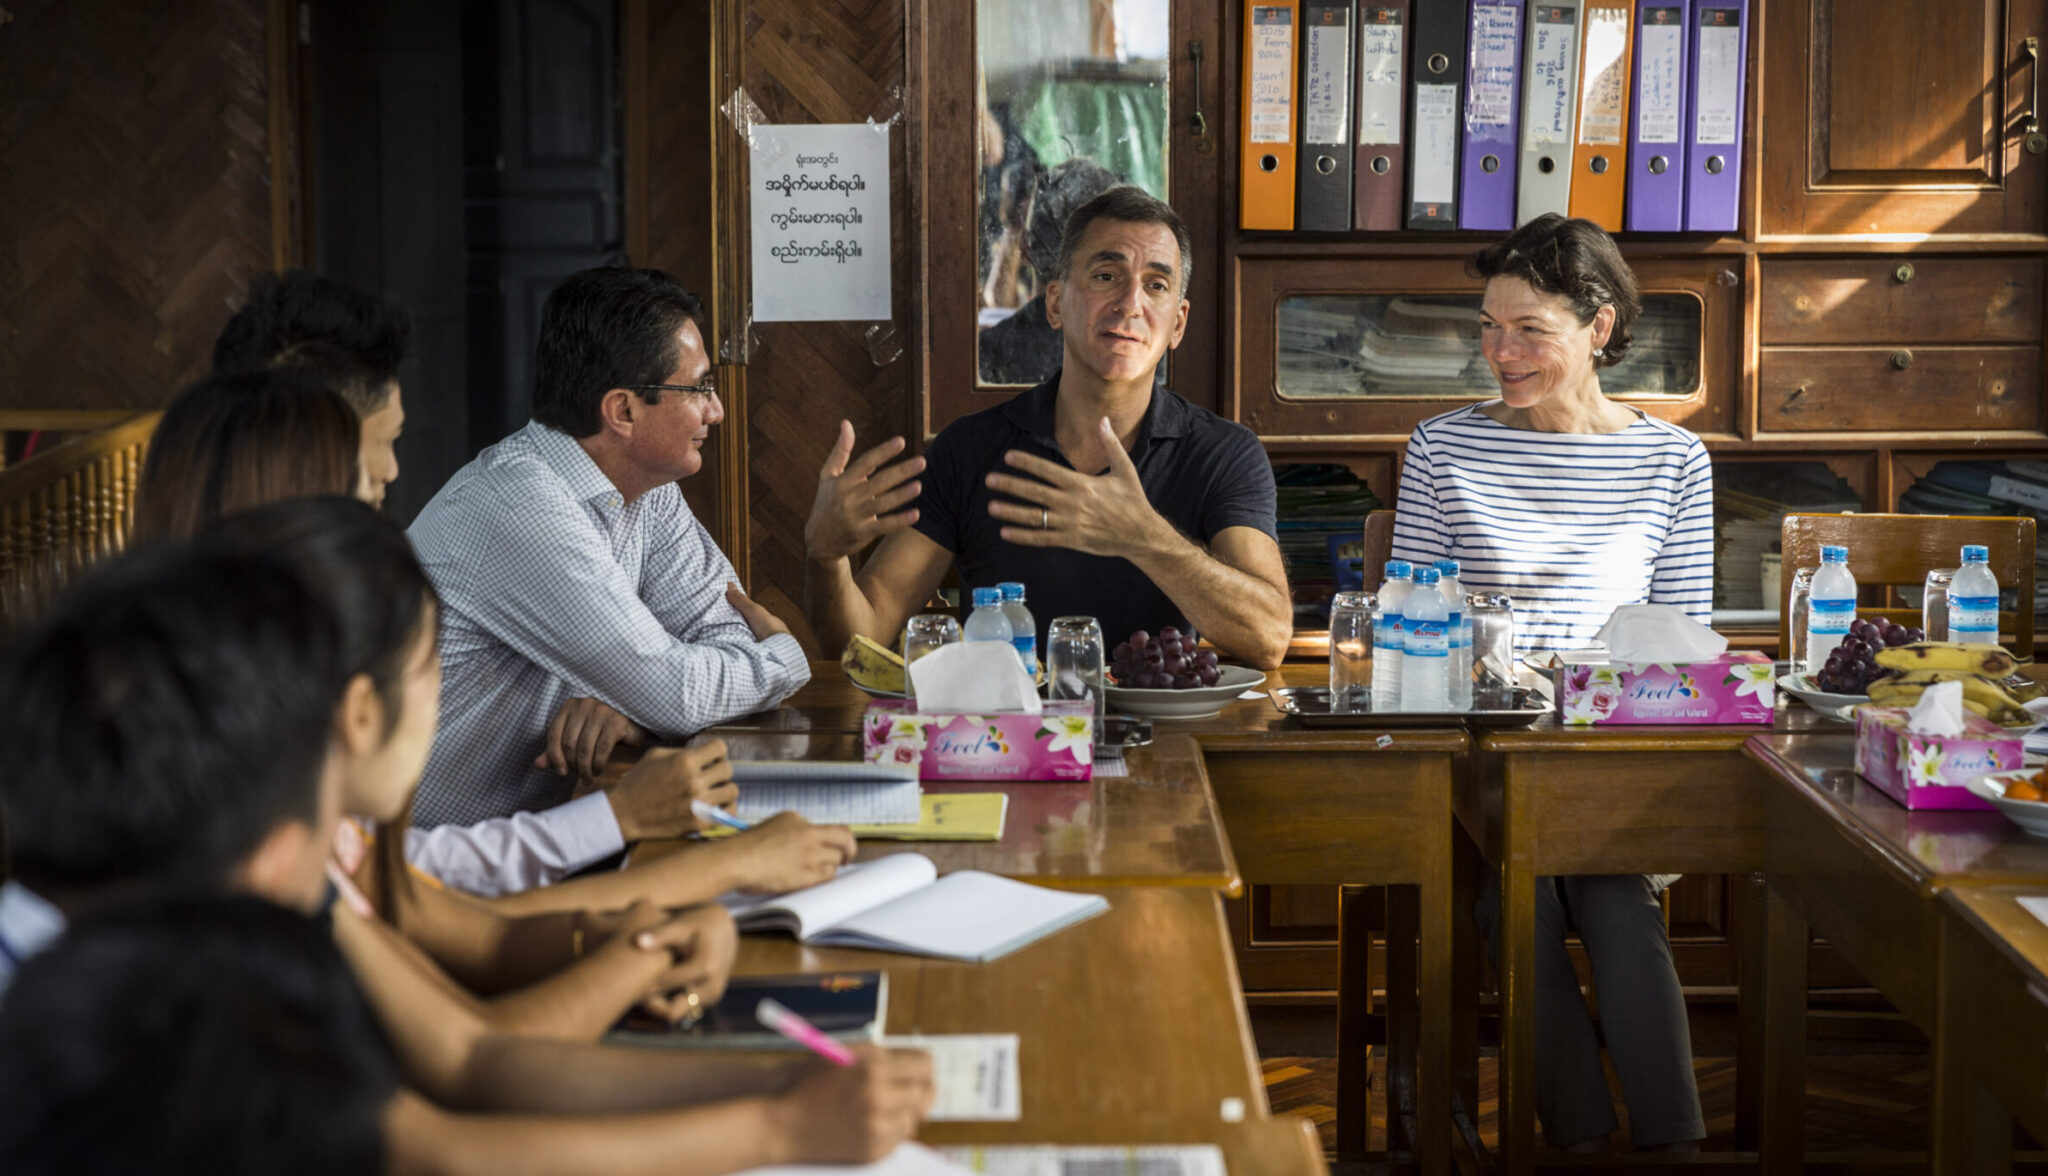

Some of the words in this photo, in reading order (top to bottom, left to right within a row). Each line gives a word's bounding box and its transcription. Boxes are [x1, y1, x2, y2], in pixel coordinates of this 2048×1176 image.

[1630, 678, 1678, 699] Feel
[934, 731, 986, 754] Feel
[1947, 752, 1985, 768] Feel
